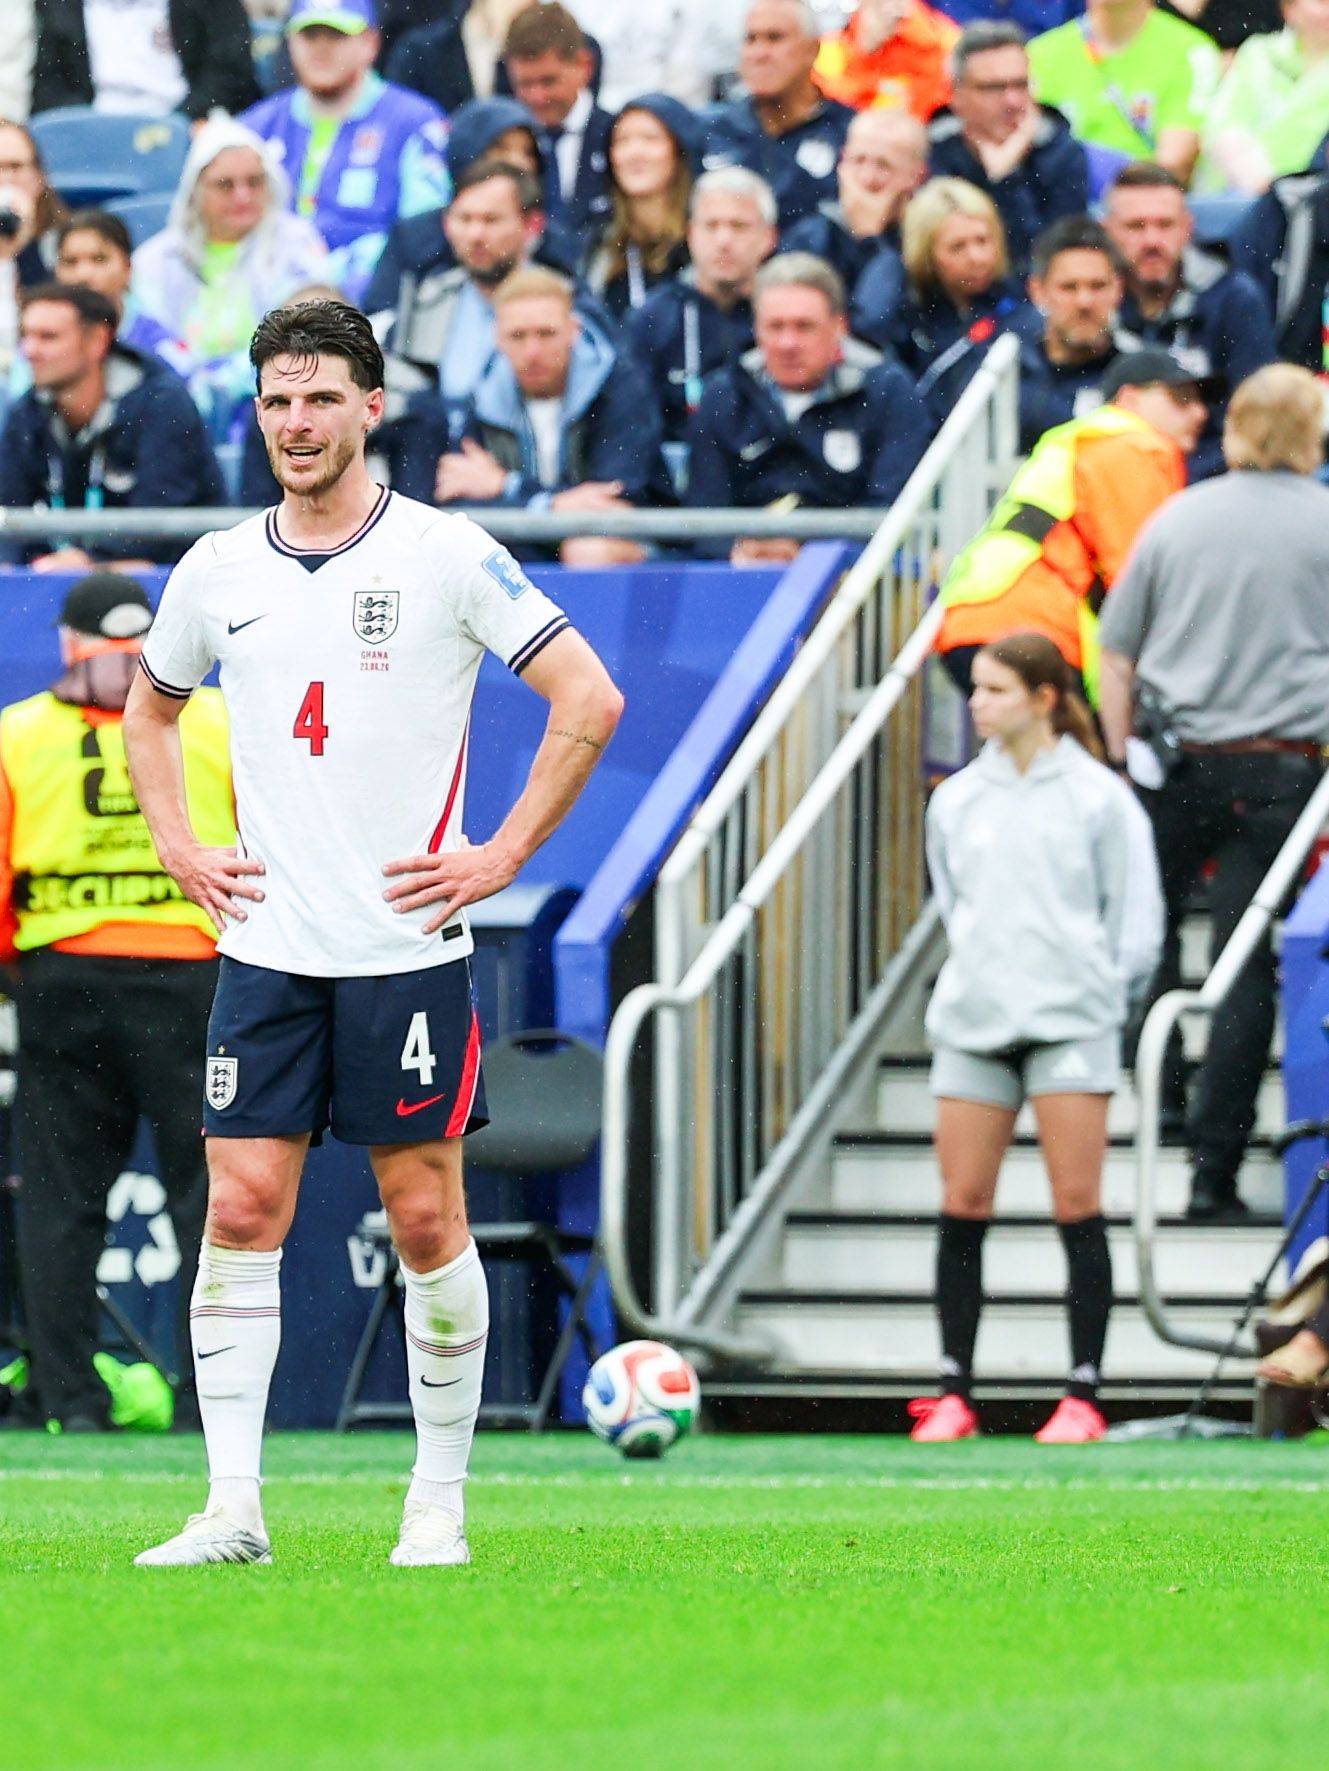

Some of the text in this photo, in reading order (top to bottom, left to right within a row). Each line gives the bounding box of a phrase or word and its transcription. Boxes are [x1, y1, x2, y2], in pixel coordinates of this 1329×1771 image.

[360, 650, 389, 659] GHANA
[293, 682, 329, 756] 4
[401, 1011, 436, 1085] 4
